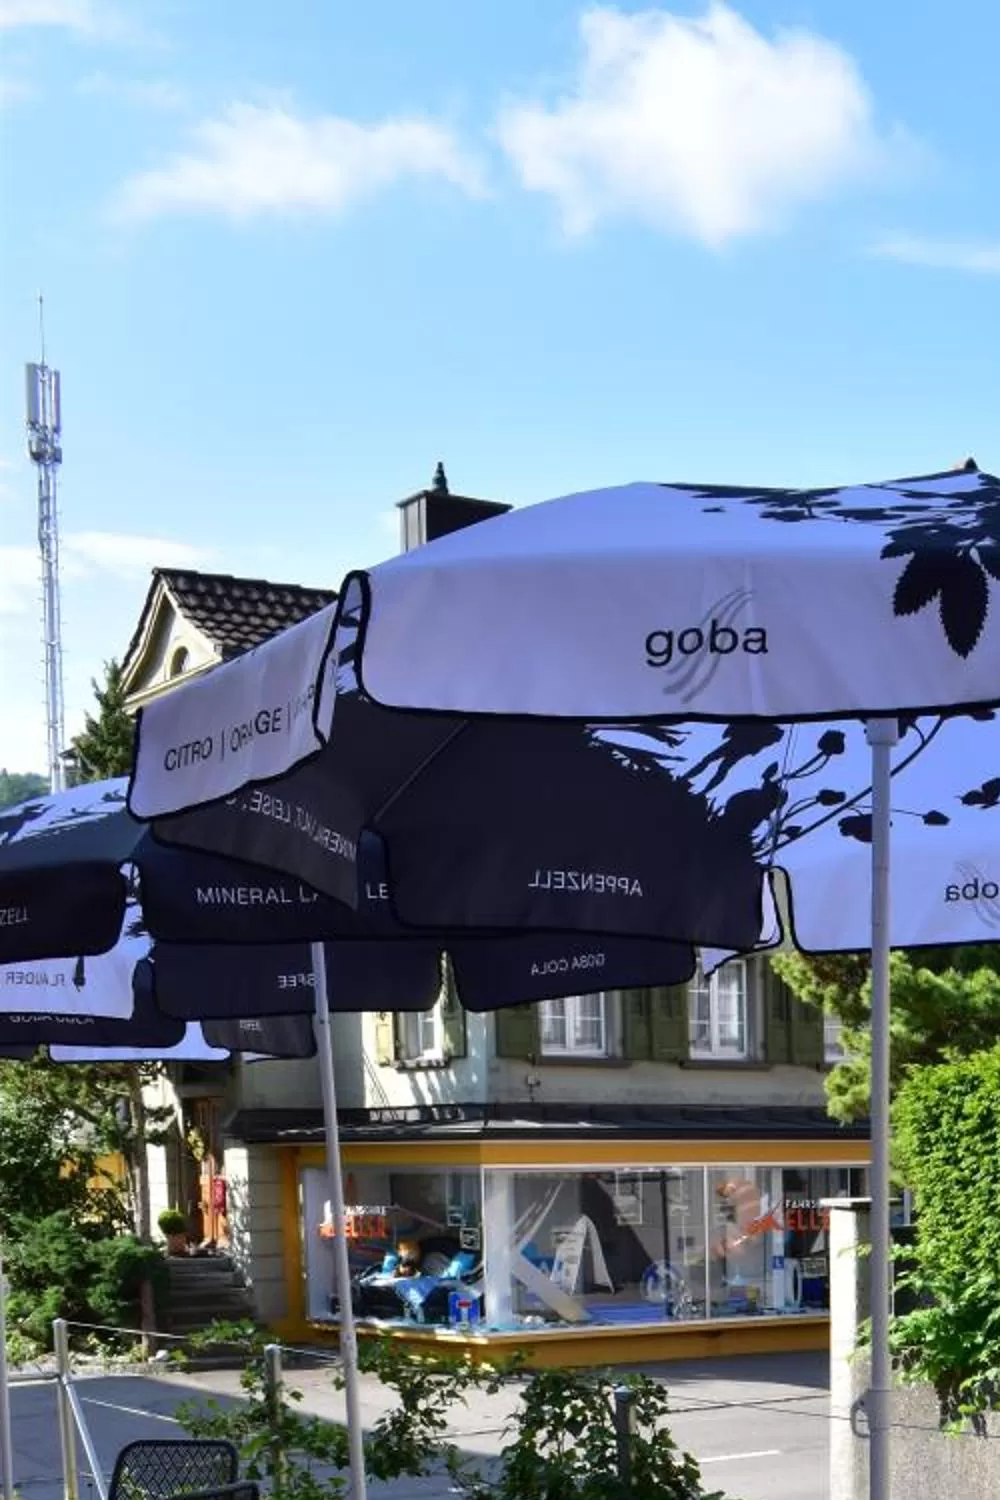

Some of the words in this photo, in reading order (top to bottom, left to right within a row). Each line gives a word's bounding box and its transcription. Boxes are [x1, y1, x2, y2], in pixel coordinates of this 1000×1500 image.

[645, 618, 769, 668] goba
[164, 736, 213, 771] CITRO
[197, 887, 292, 905] MINERAL
